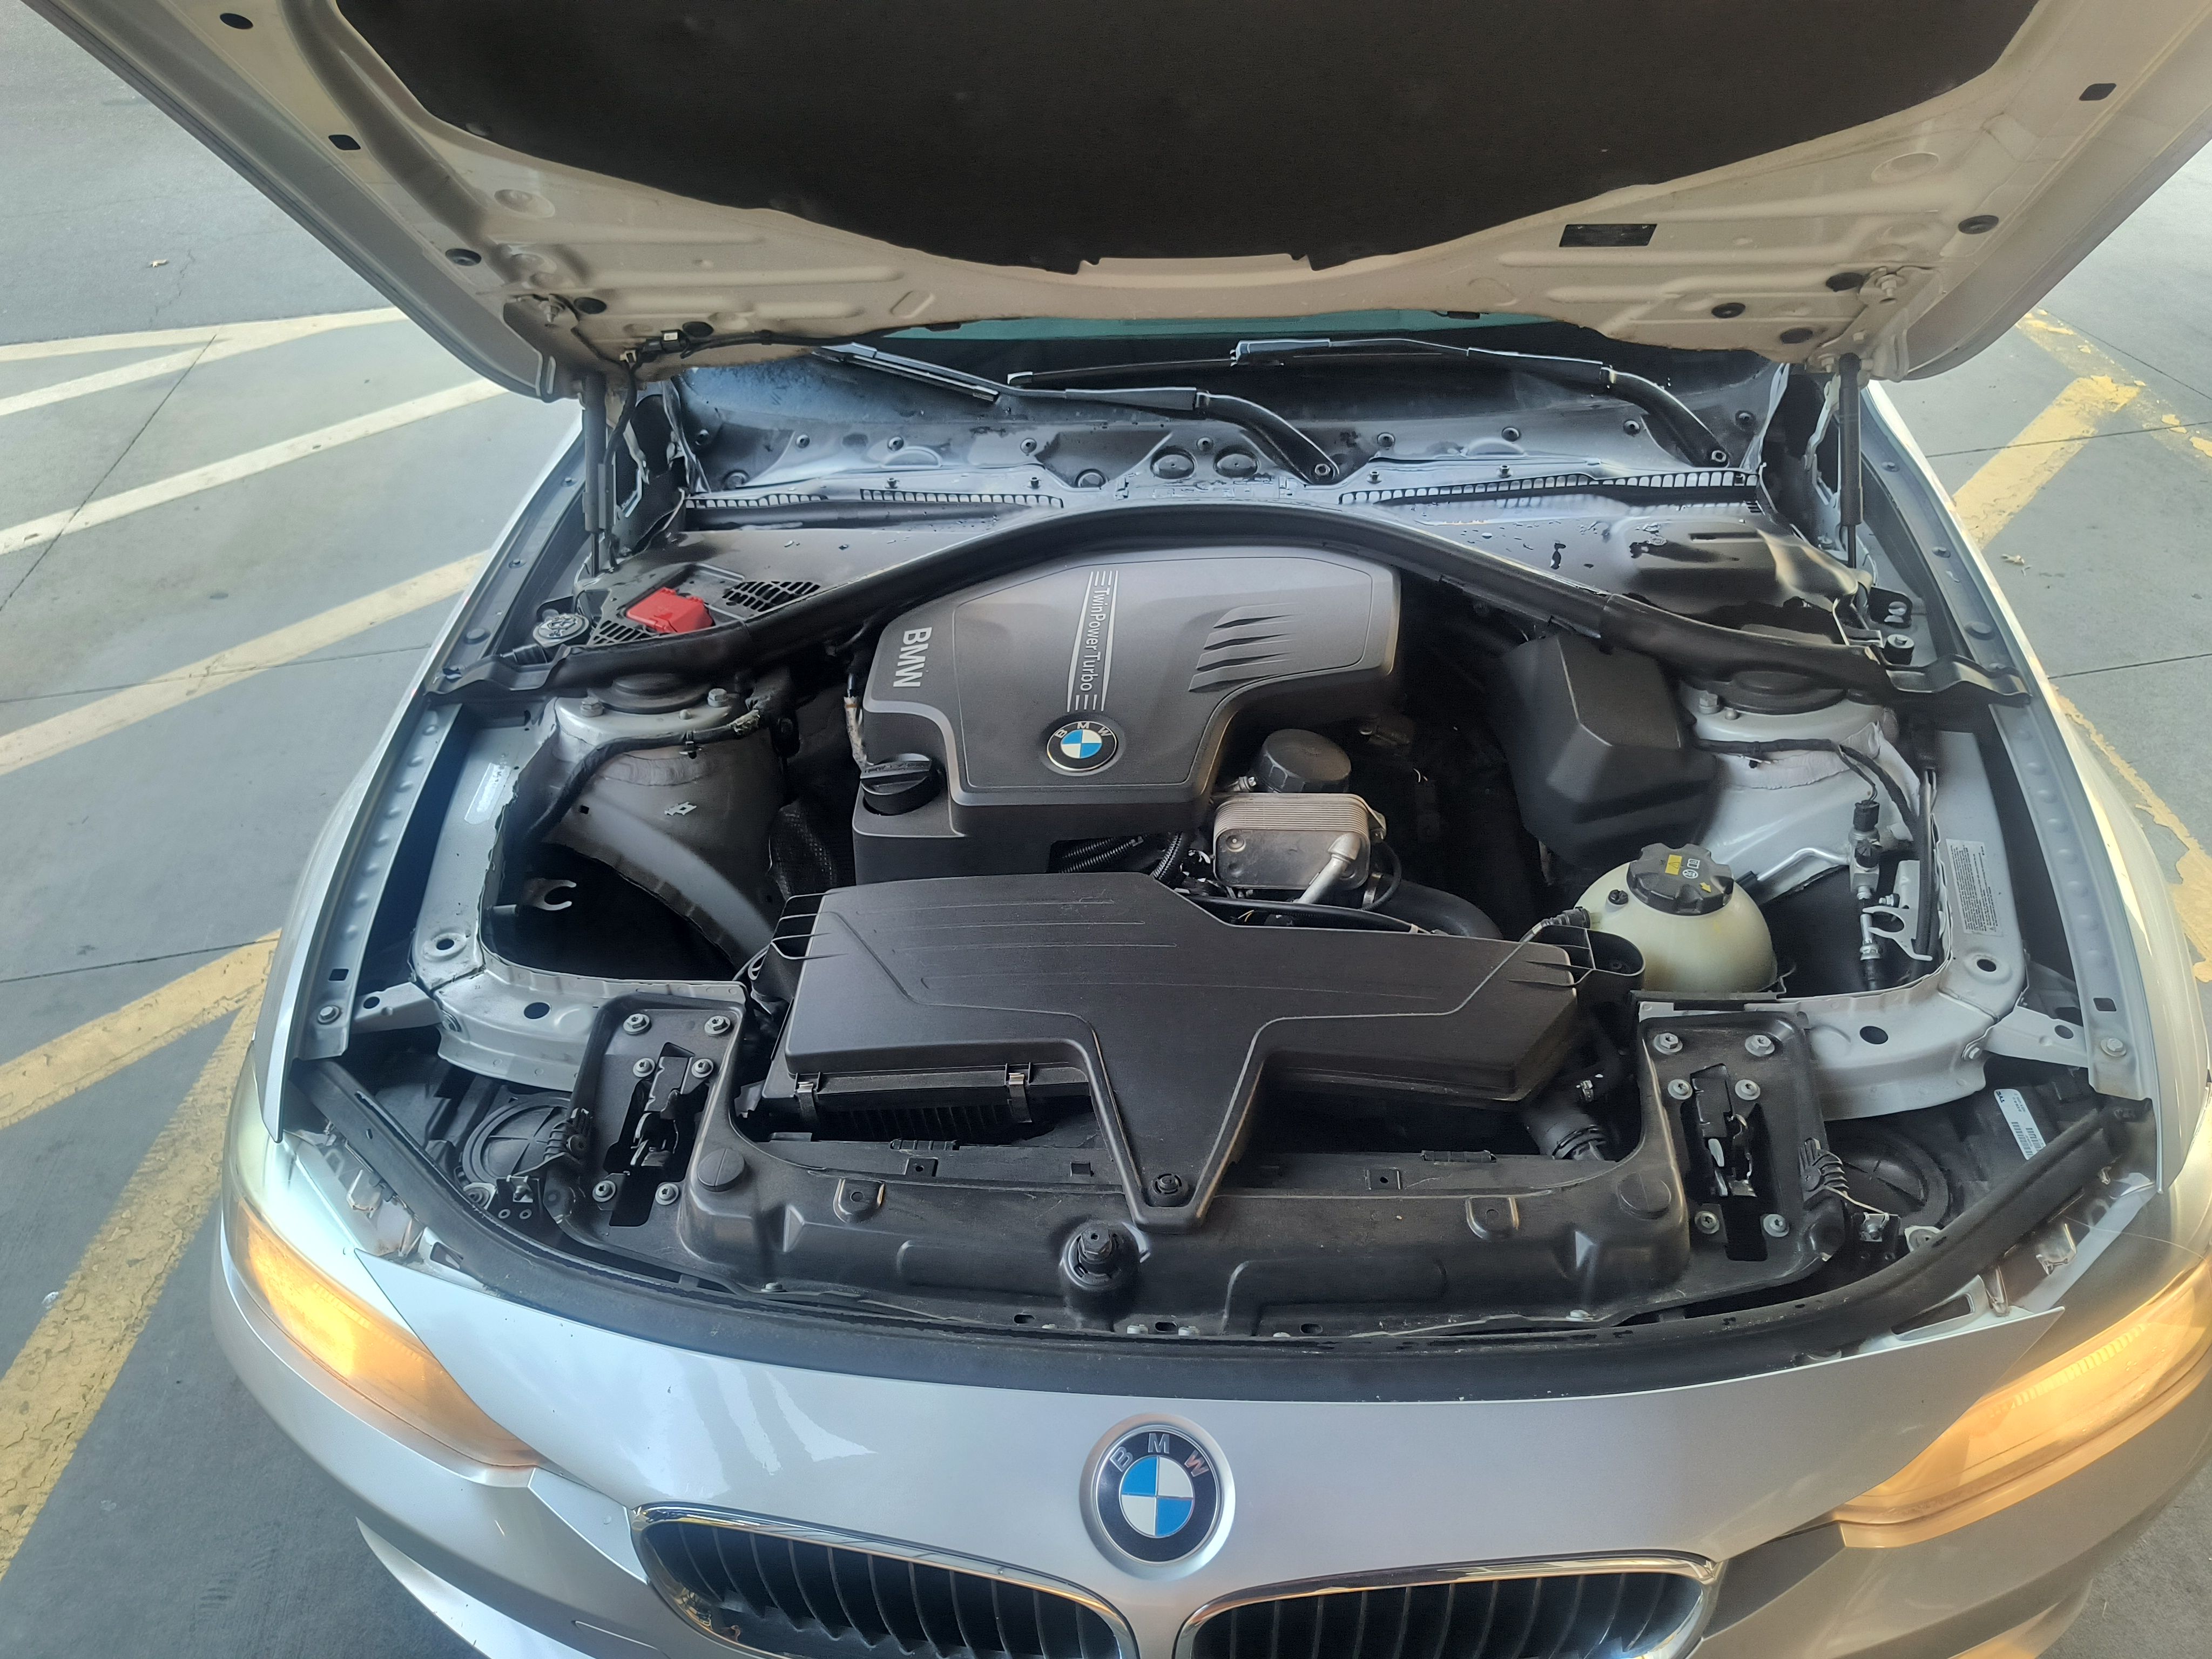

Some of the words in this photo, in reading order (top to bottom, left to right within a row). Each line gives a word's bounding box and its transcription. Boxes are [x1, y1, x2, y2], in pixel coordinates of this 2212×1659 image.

[1085, 587, 1110, 651] TwinPower
[893, 627, 932, 687] BMW
[1080, 651, 1101, 692] Turbo
[1054, 721, 1111, 738] BMW
[1109, 1432, 1209, 1477] BMW
